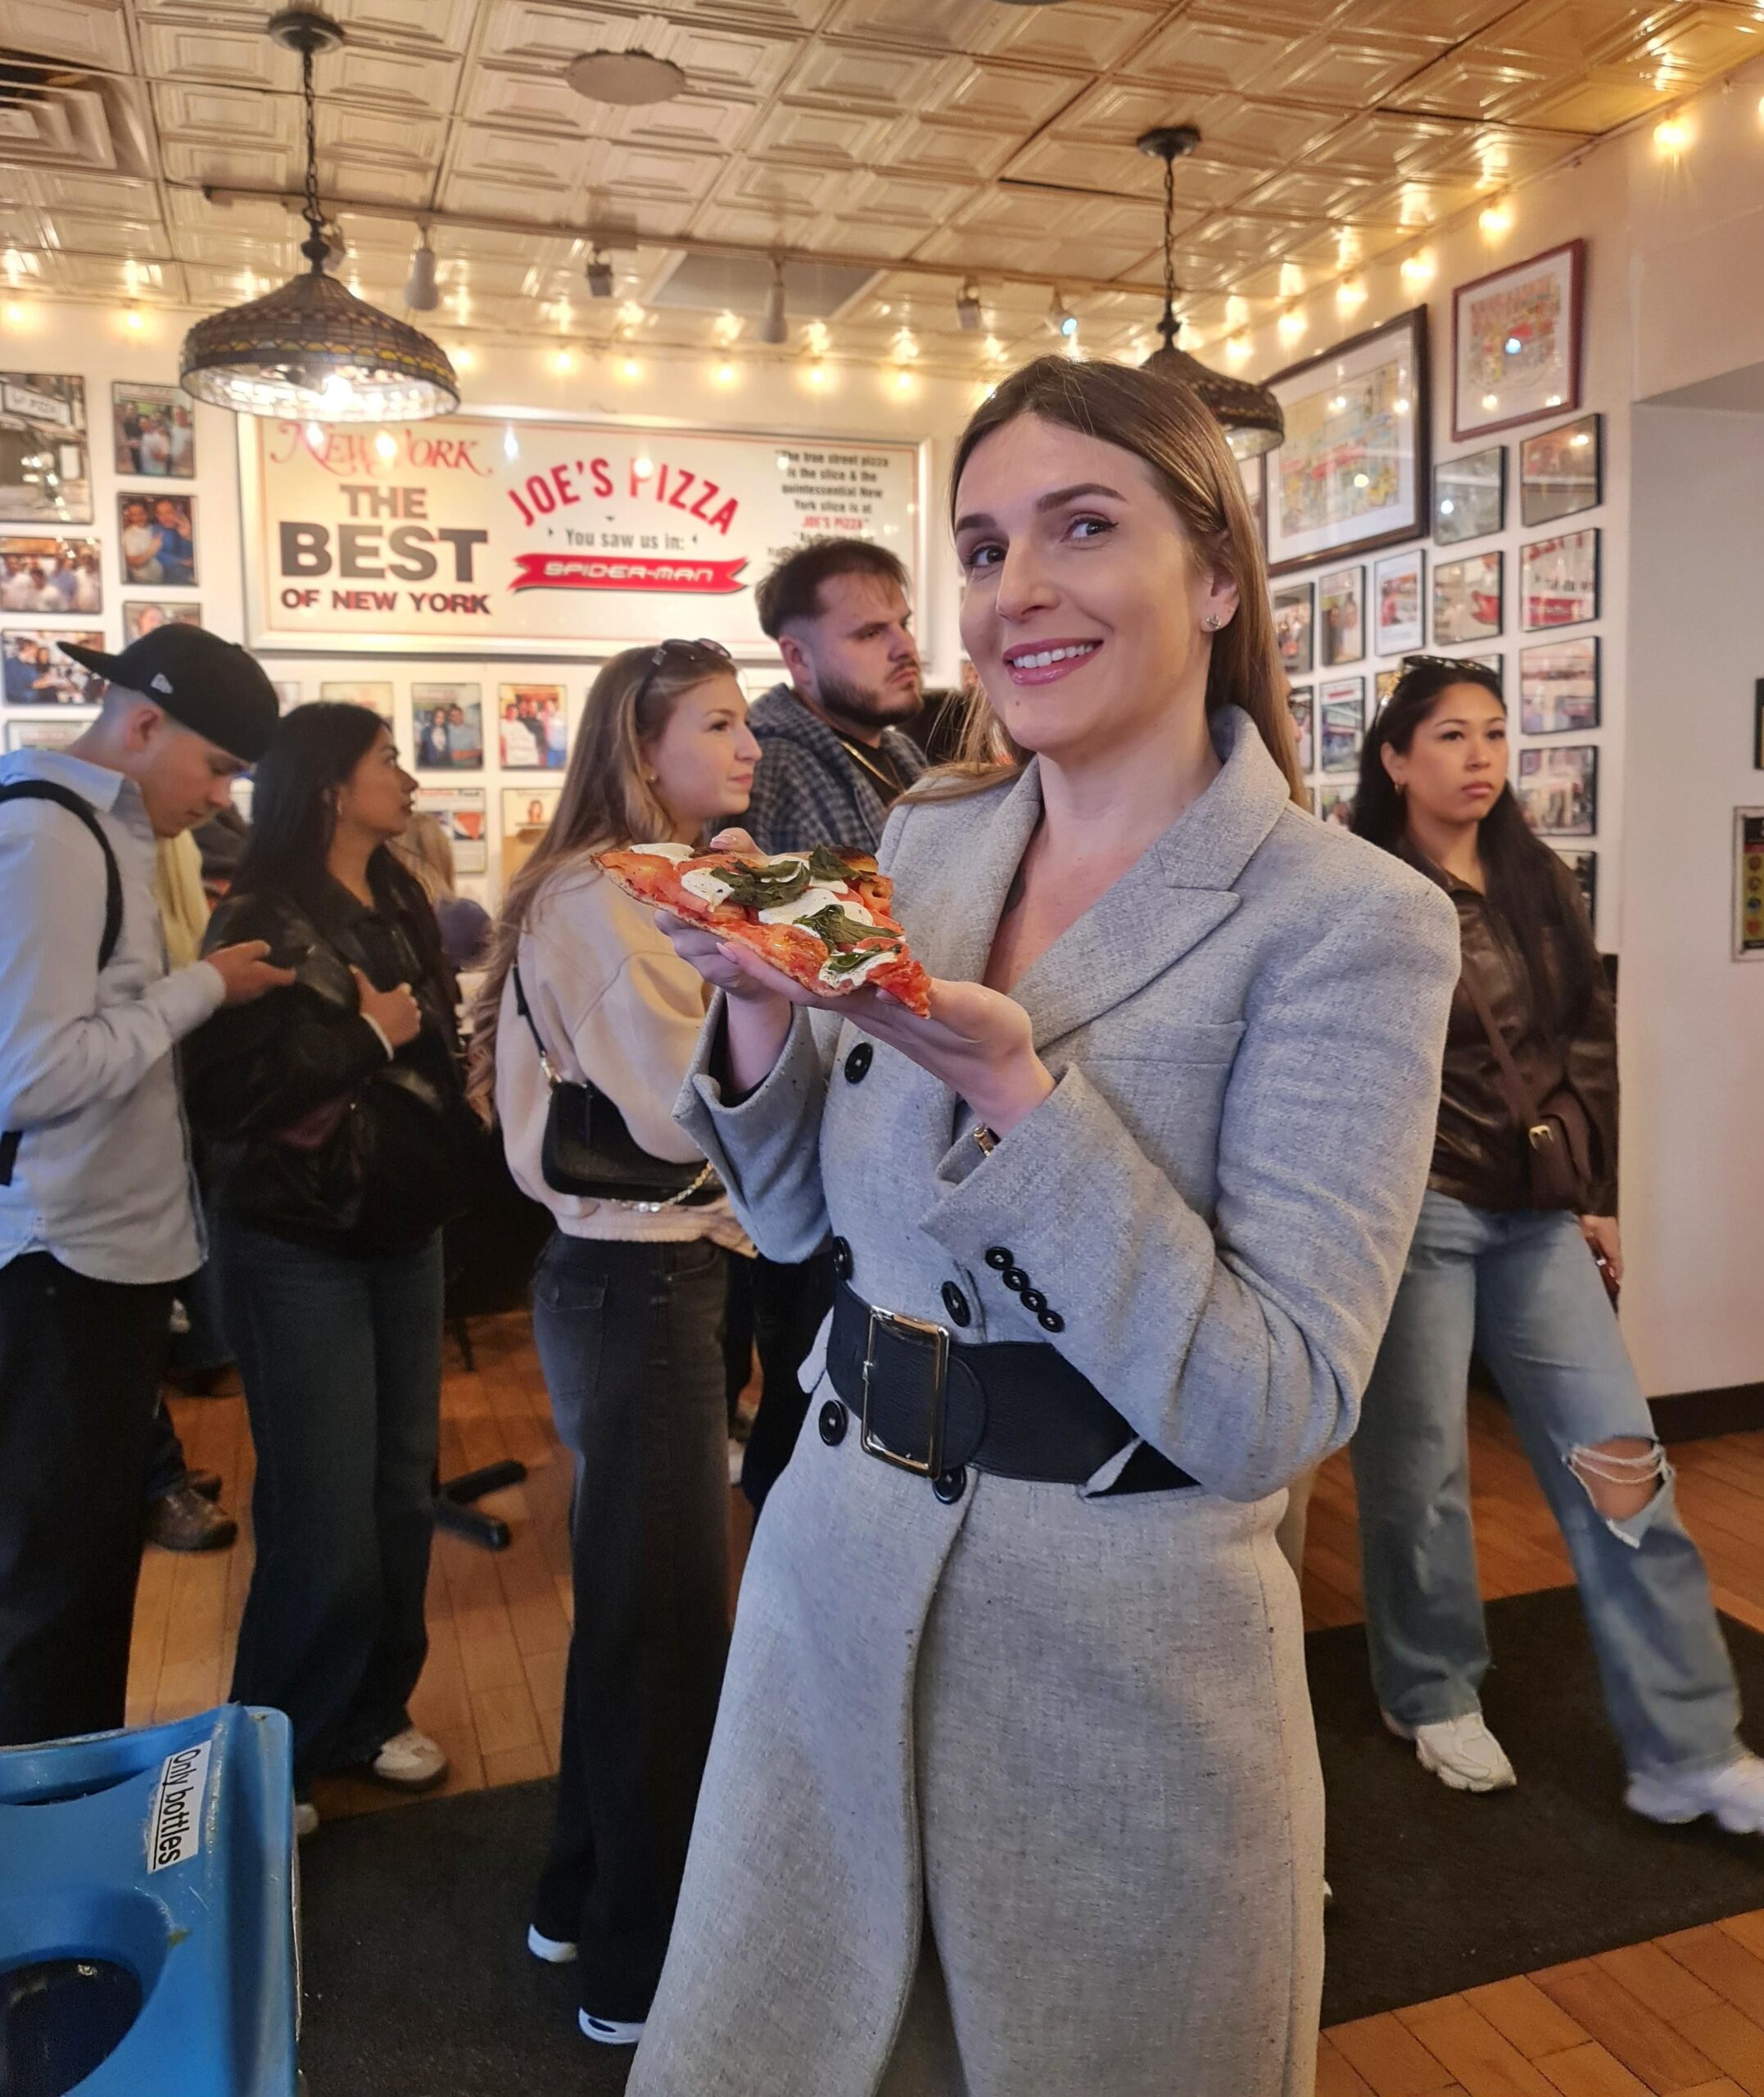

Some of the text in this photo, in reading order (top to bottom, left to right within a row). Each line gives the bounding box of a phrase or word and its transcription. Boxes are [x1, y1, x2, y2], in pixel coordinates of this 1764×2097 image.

[803, 452, 825, 464] true
[828, 454, 858, 465] street
[862, 455, 889, 468] pizza
[800, 469, 816, 479] the
[820, 470, 846, 481] slice
[861, 472, 877, 482] the
[340, 484, 427, 519] THE
[508, 458, 739, 536] JOE'S PIZZA
[781, 484, 884, 498] quintessential New
[794, 499, 816, 510] York
[821, 500, 846, 512] slice
[849, 502, 858, 513] is
[566, 529, 685, 550] You saw us in:
[278, 522, 488, 583] BEST
[544, 561, 714, 582] SPIDER-MAN
[281, 589, 491, 614] OF NEW YORK
[158, 1748, 201, 1865] Only bottles
